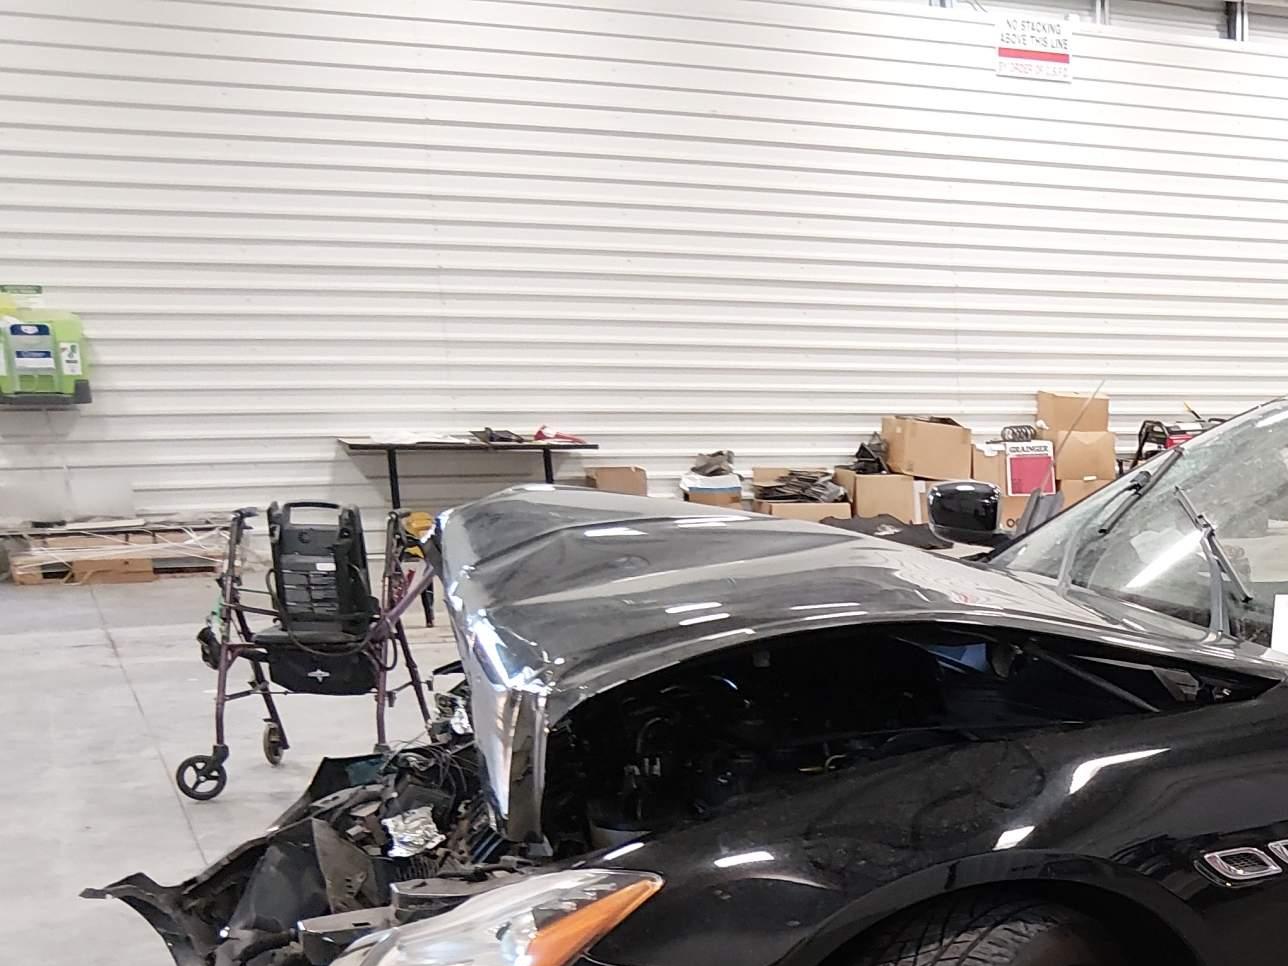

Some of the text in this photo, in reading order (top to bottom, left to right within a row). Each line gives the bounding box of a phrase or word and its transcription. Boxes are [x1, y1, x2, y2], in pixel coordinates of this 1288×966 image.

[1006, 18, 1061, 35] NO STACKING
[1000, 32, 1069, 50] ABOVE THIS LINE
[1009, 445, 1049, 453] GRAINGER
